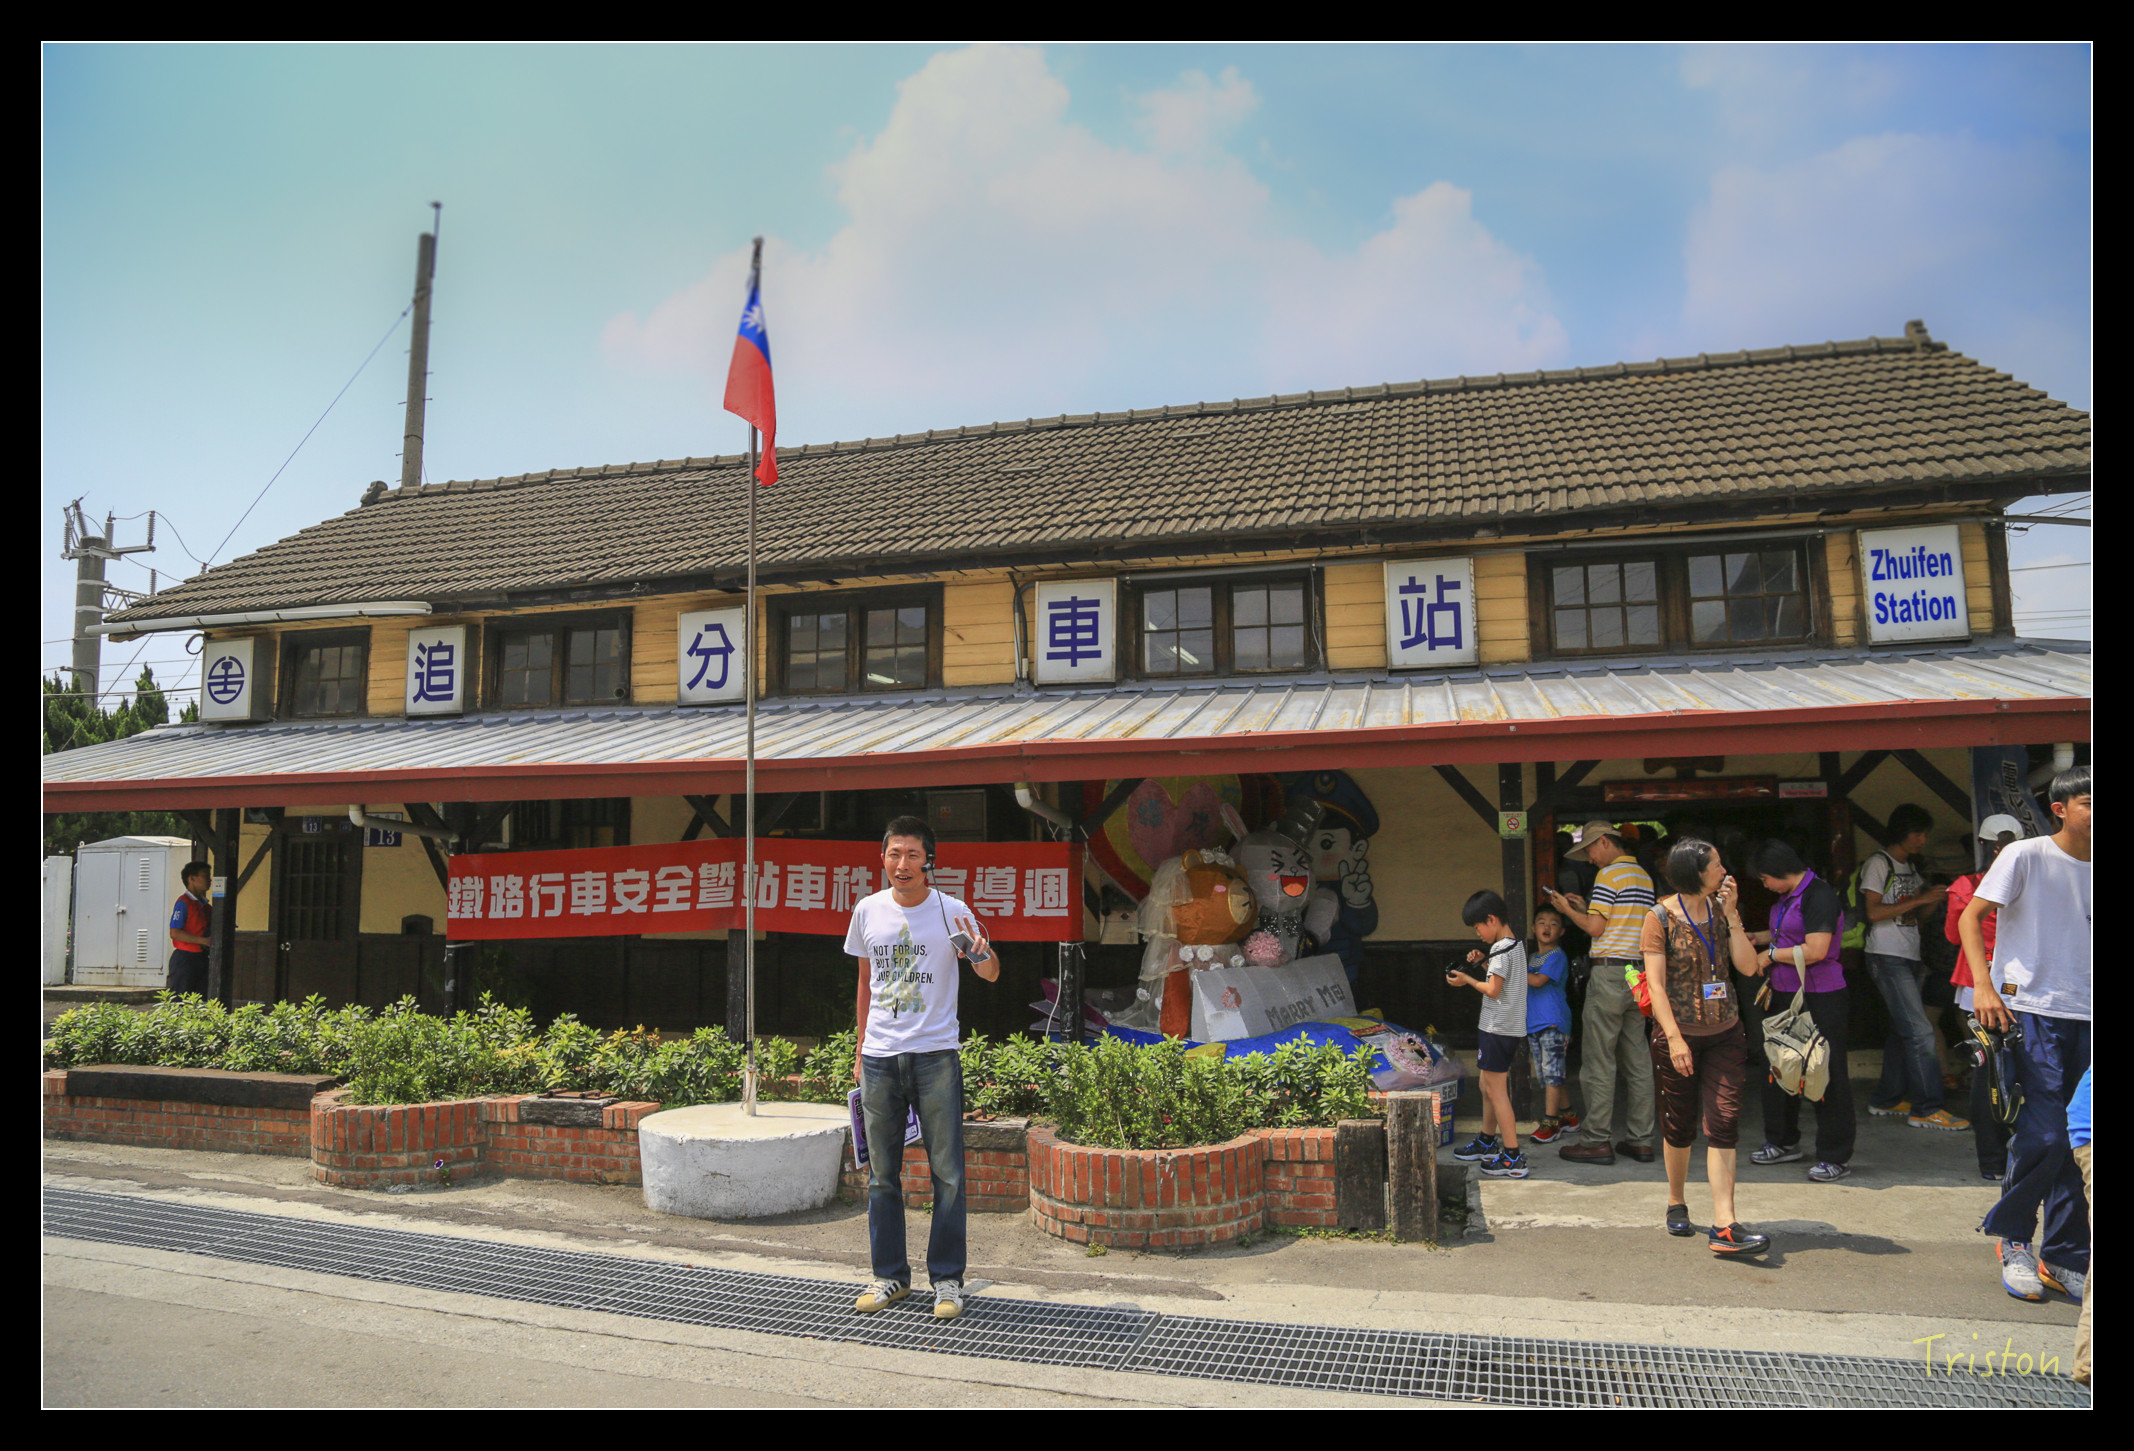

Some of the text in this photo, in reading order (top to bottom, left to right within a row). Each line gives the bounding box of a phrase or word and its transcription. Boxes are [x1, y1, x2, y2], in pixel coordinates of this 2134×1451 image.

[1870, 546, 1953, 581] Zhuifen
[1399, 574, 1463, 652] 站
[1874, 589, 1957, 625] Station
[1046, 595, 1102, 668] 車
[412, 639, 456, 704] 追
[686, 622, 736, 691] 分
[377, 828, 395, 845] 13
[447, 860, 1069, 919] 鐵路行車安全暨站車秩宣導週
[873, 945, 928, 957] NOT FOR US,
[876, 958, 910, 969] BUT FOR
